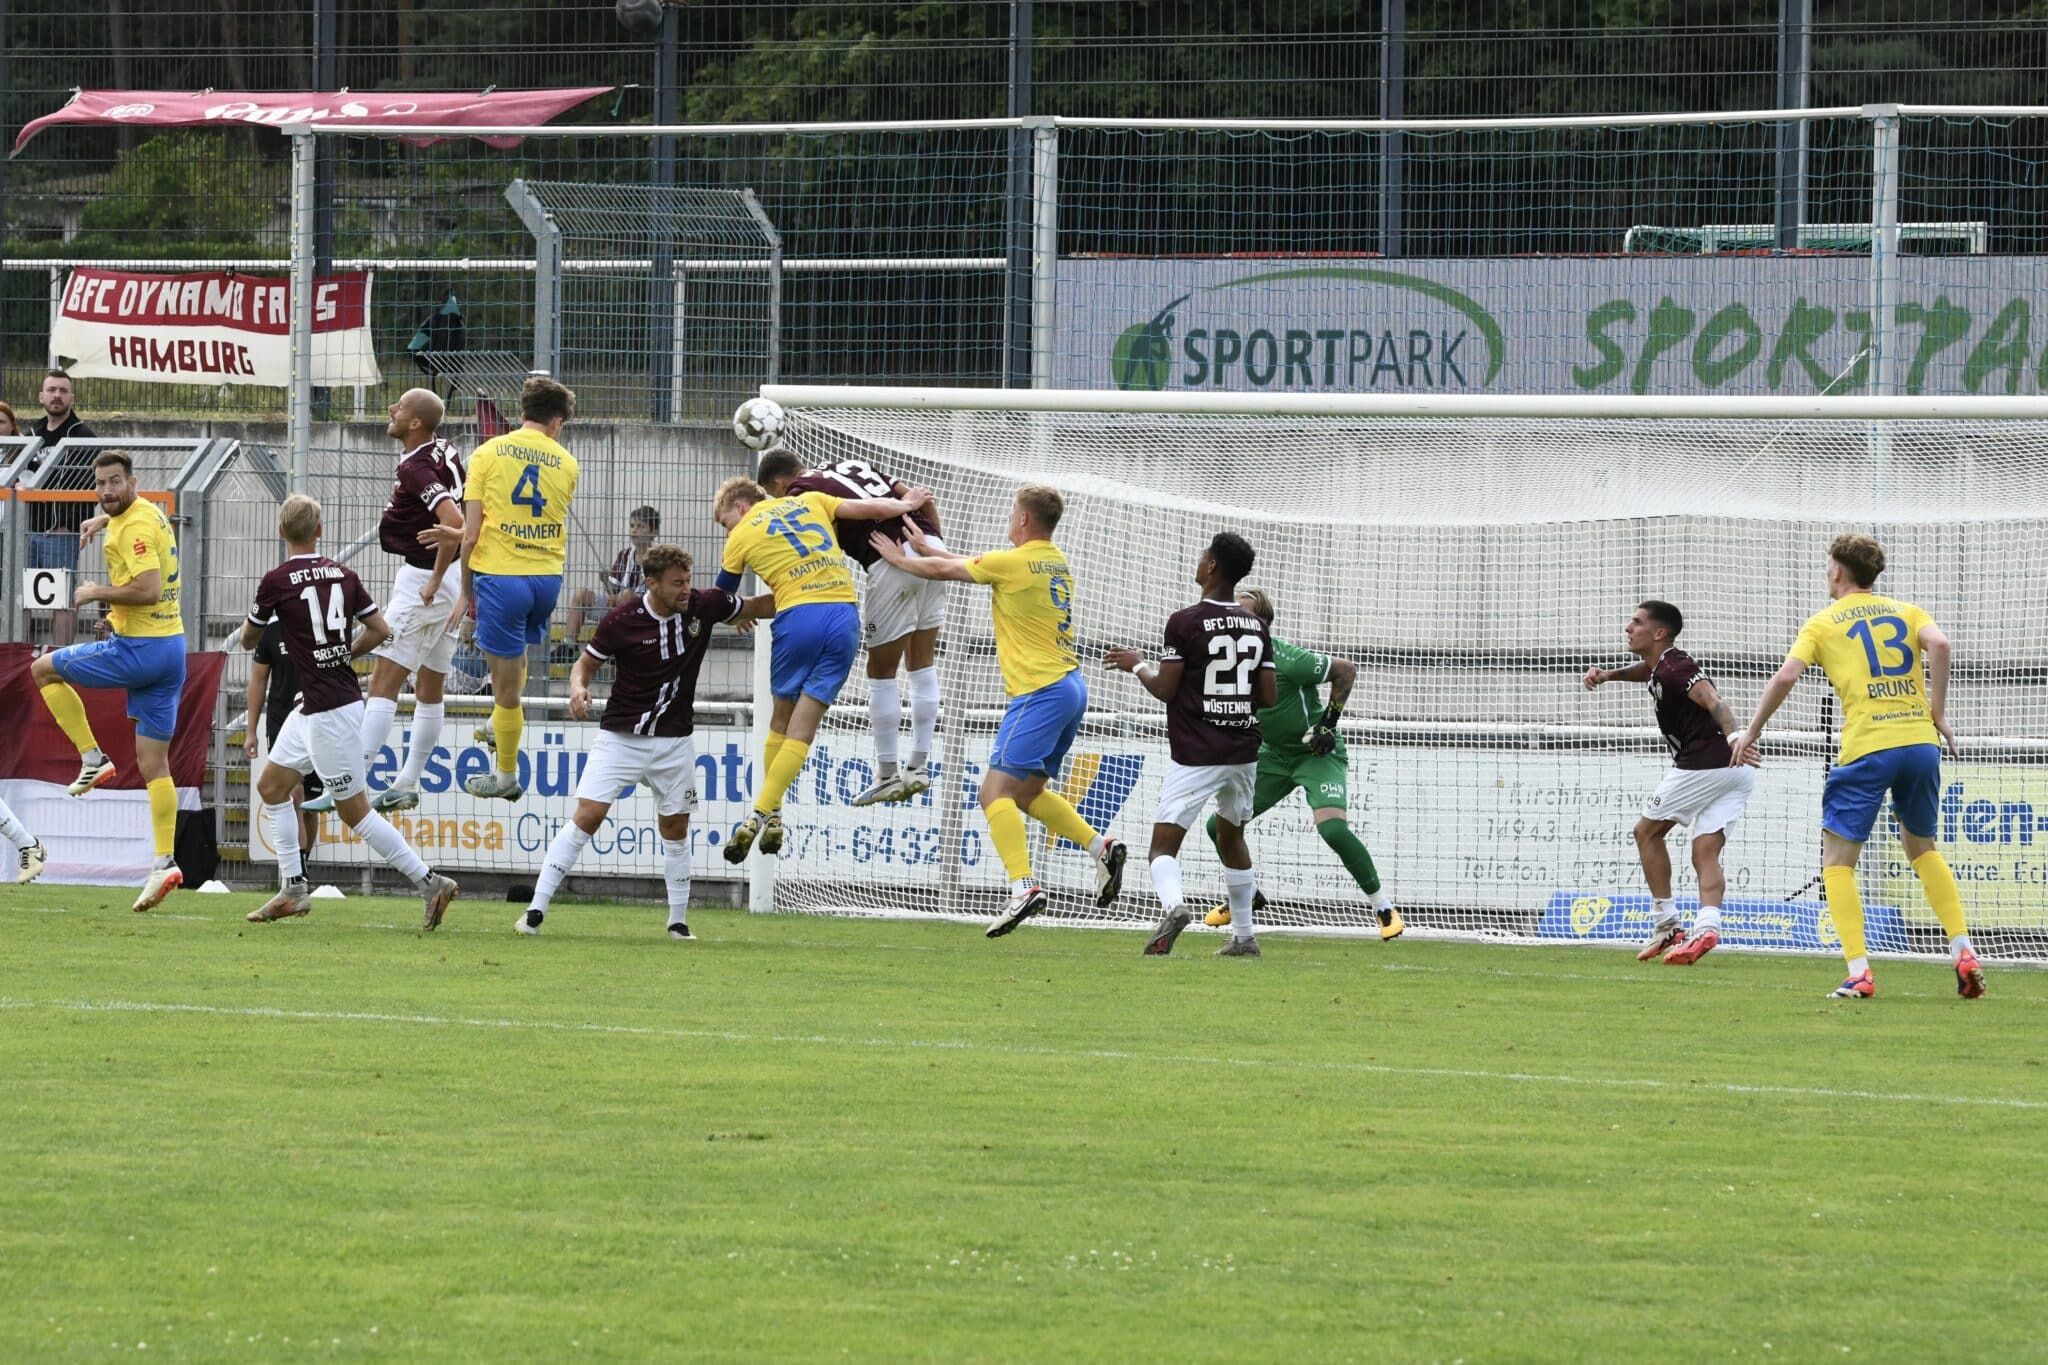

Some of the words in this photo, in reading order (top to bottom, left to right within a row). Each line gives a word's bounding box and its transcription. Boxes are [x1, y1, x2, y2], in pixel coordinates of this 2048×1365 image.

[67, 275, 118, 315] BFC
[118, 279, 244, 321] DYNAMO
[253, 285, 339, 324] FAS
[109, 336, 255, 376] HAMBURG
[1183, 328, 1468, 388] SPORTPARK
[496, 445, 562, 470] LUCKENWALDE
[822, 460, 891, 499] 13
[511, 463, 548, 518] 4
[766, 506, 834, 559] 15
[33, 571, 55, 606] C
[289, 569, 311, 585] BFC
[300, 583, 347, 646] 14
[1049, 576, 1071, 633] 9
[1203, 617, 1225, 632] BFC
[1203, 635, 1264, 695] 22
[1846, 615, 1914, 679] 13
[1867, 679, 1917, 700] BRUNS
[517, 812, 563, 853] Cit
